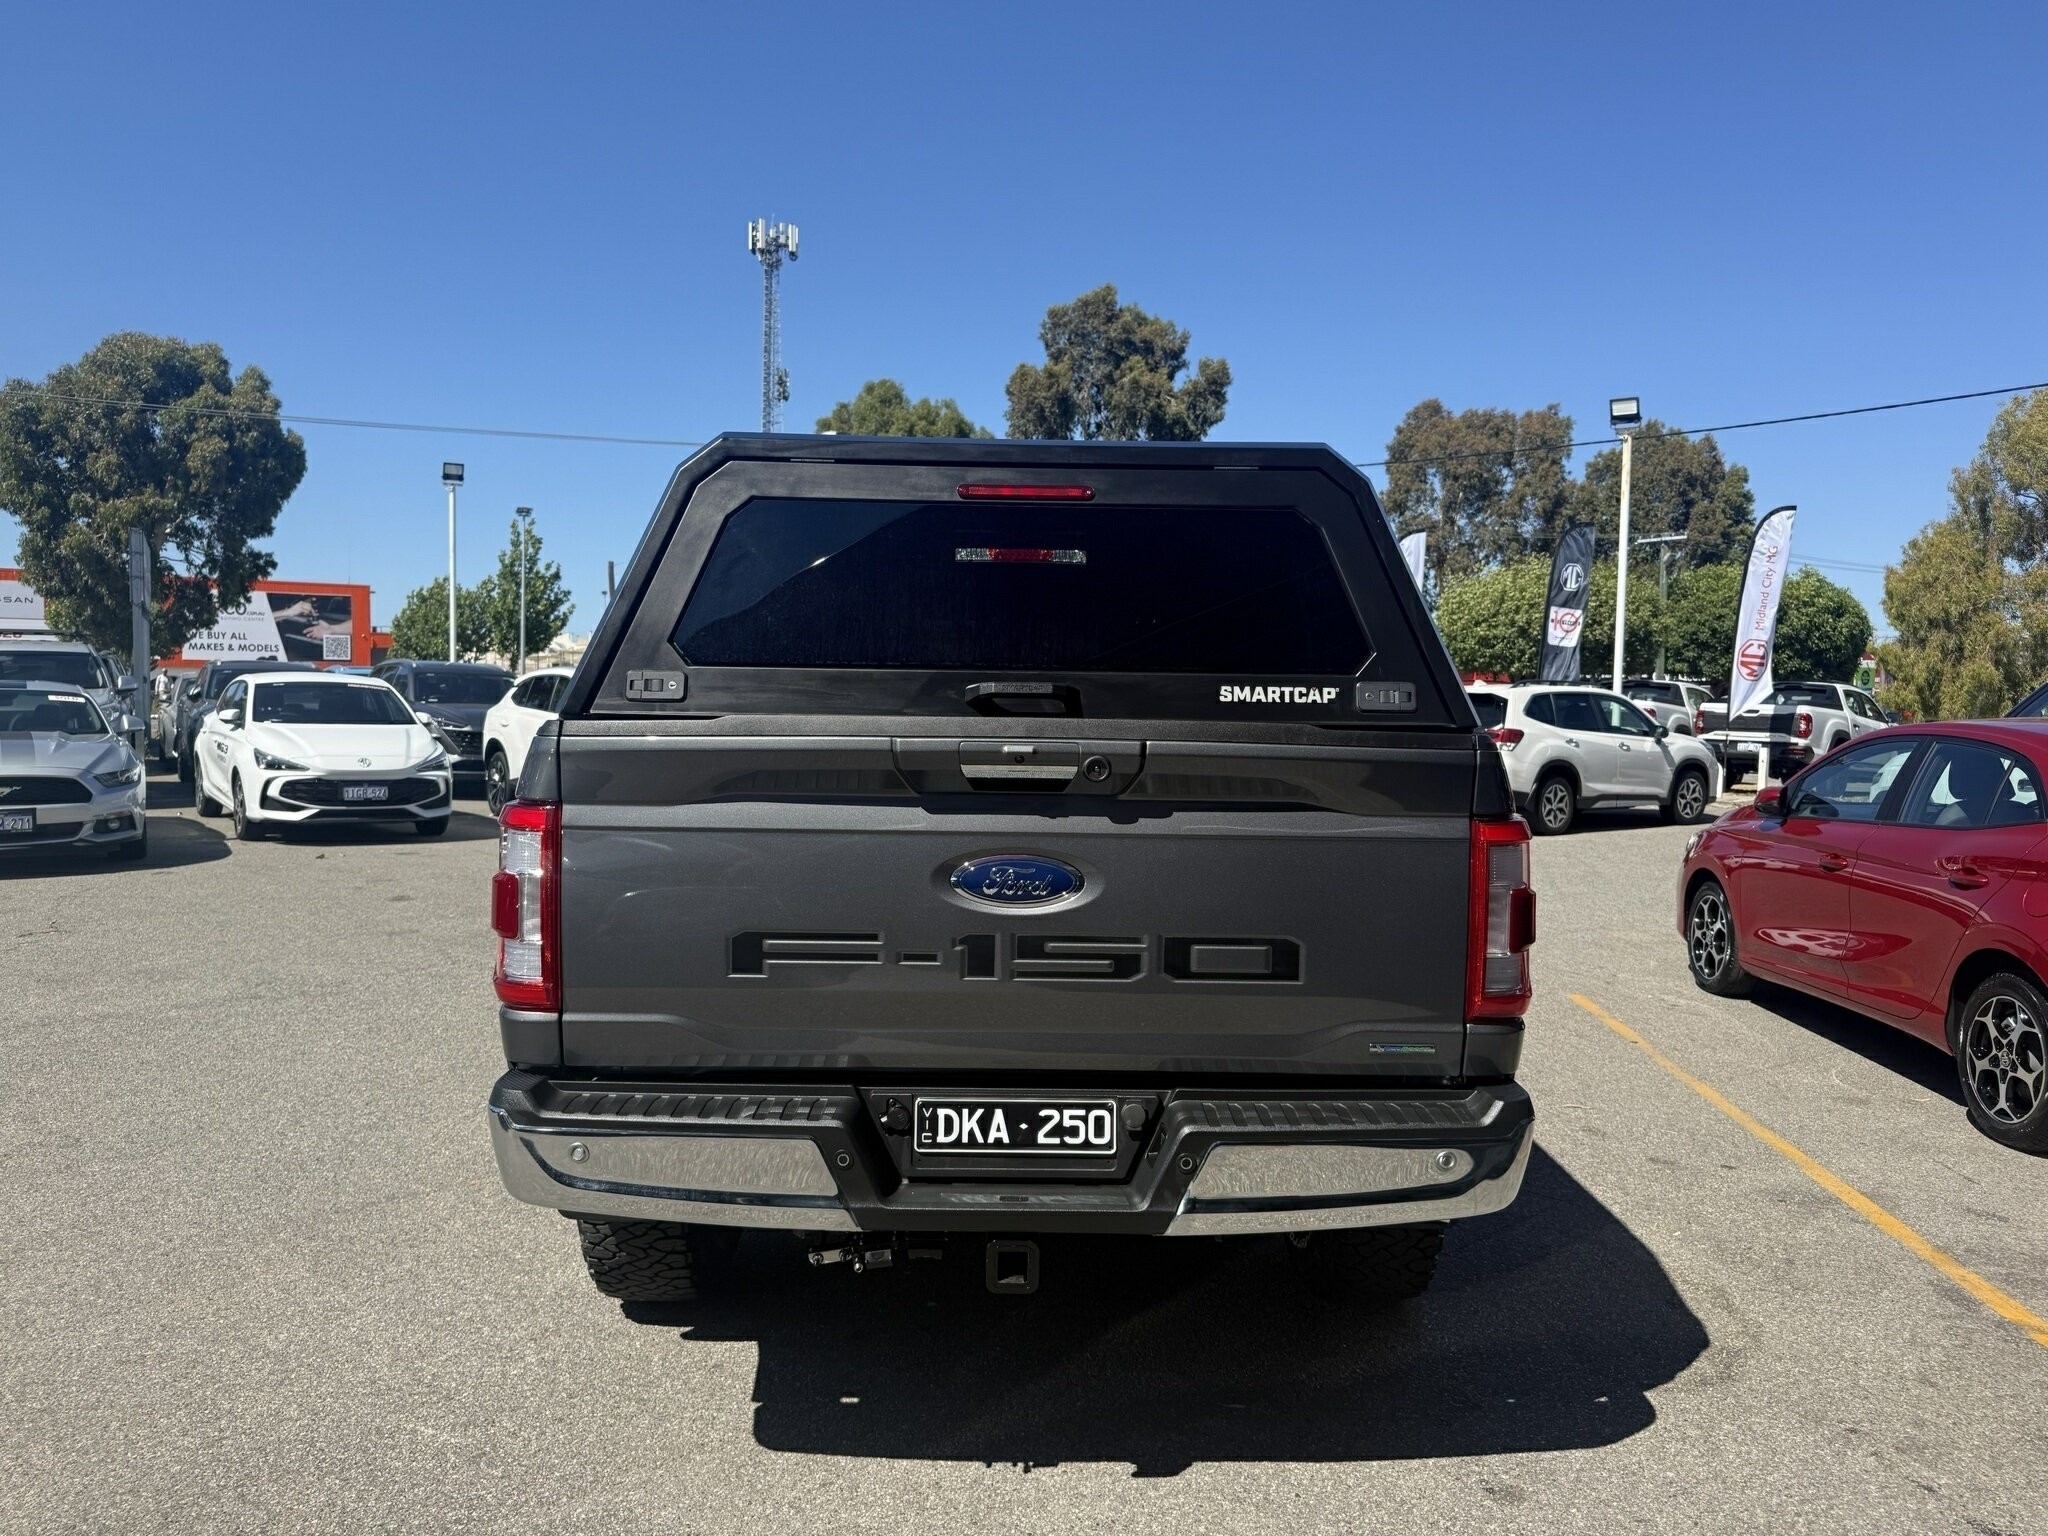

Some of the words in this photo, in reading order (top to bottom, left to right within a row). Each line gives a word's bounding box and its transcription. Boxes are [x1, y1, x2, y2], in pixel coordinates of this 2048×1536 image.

[1767, 545, 1779, 564] MG
[1561, 564, 1583, 590] MG
[1762, 567, 1776, 589] City
[0, 596, 33, 604] SAN
[1755, 592, 1769, 631] Midland
[188, 642, 225, 651] MAKES
[238, 644, 280, 653] MODELS
[207, 631, 226, 640] BUY
[230, 632, 248, 641] ALL
[1738, 641, 1767, 680] MG
[982, 865, 1054, 896] Ford
[727, 930, 1304, 984] F-150
[921, 1107, 933, 1143] VIC
[1037, 1109, 1112, 1145] 250
